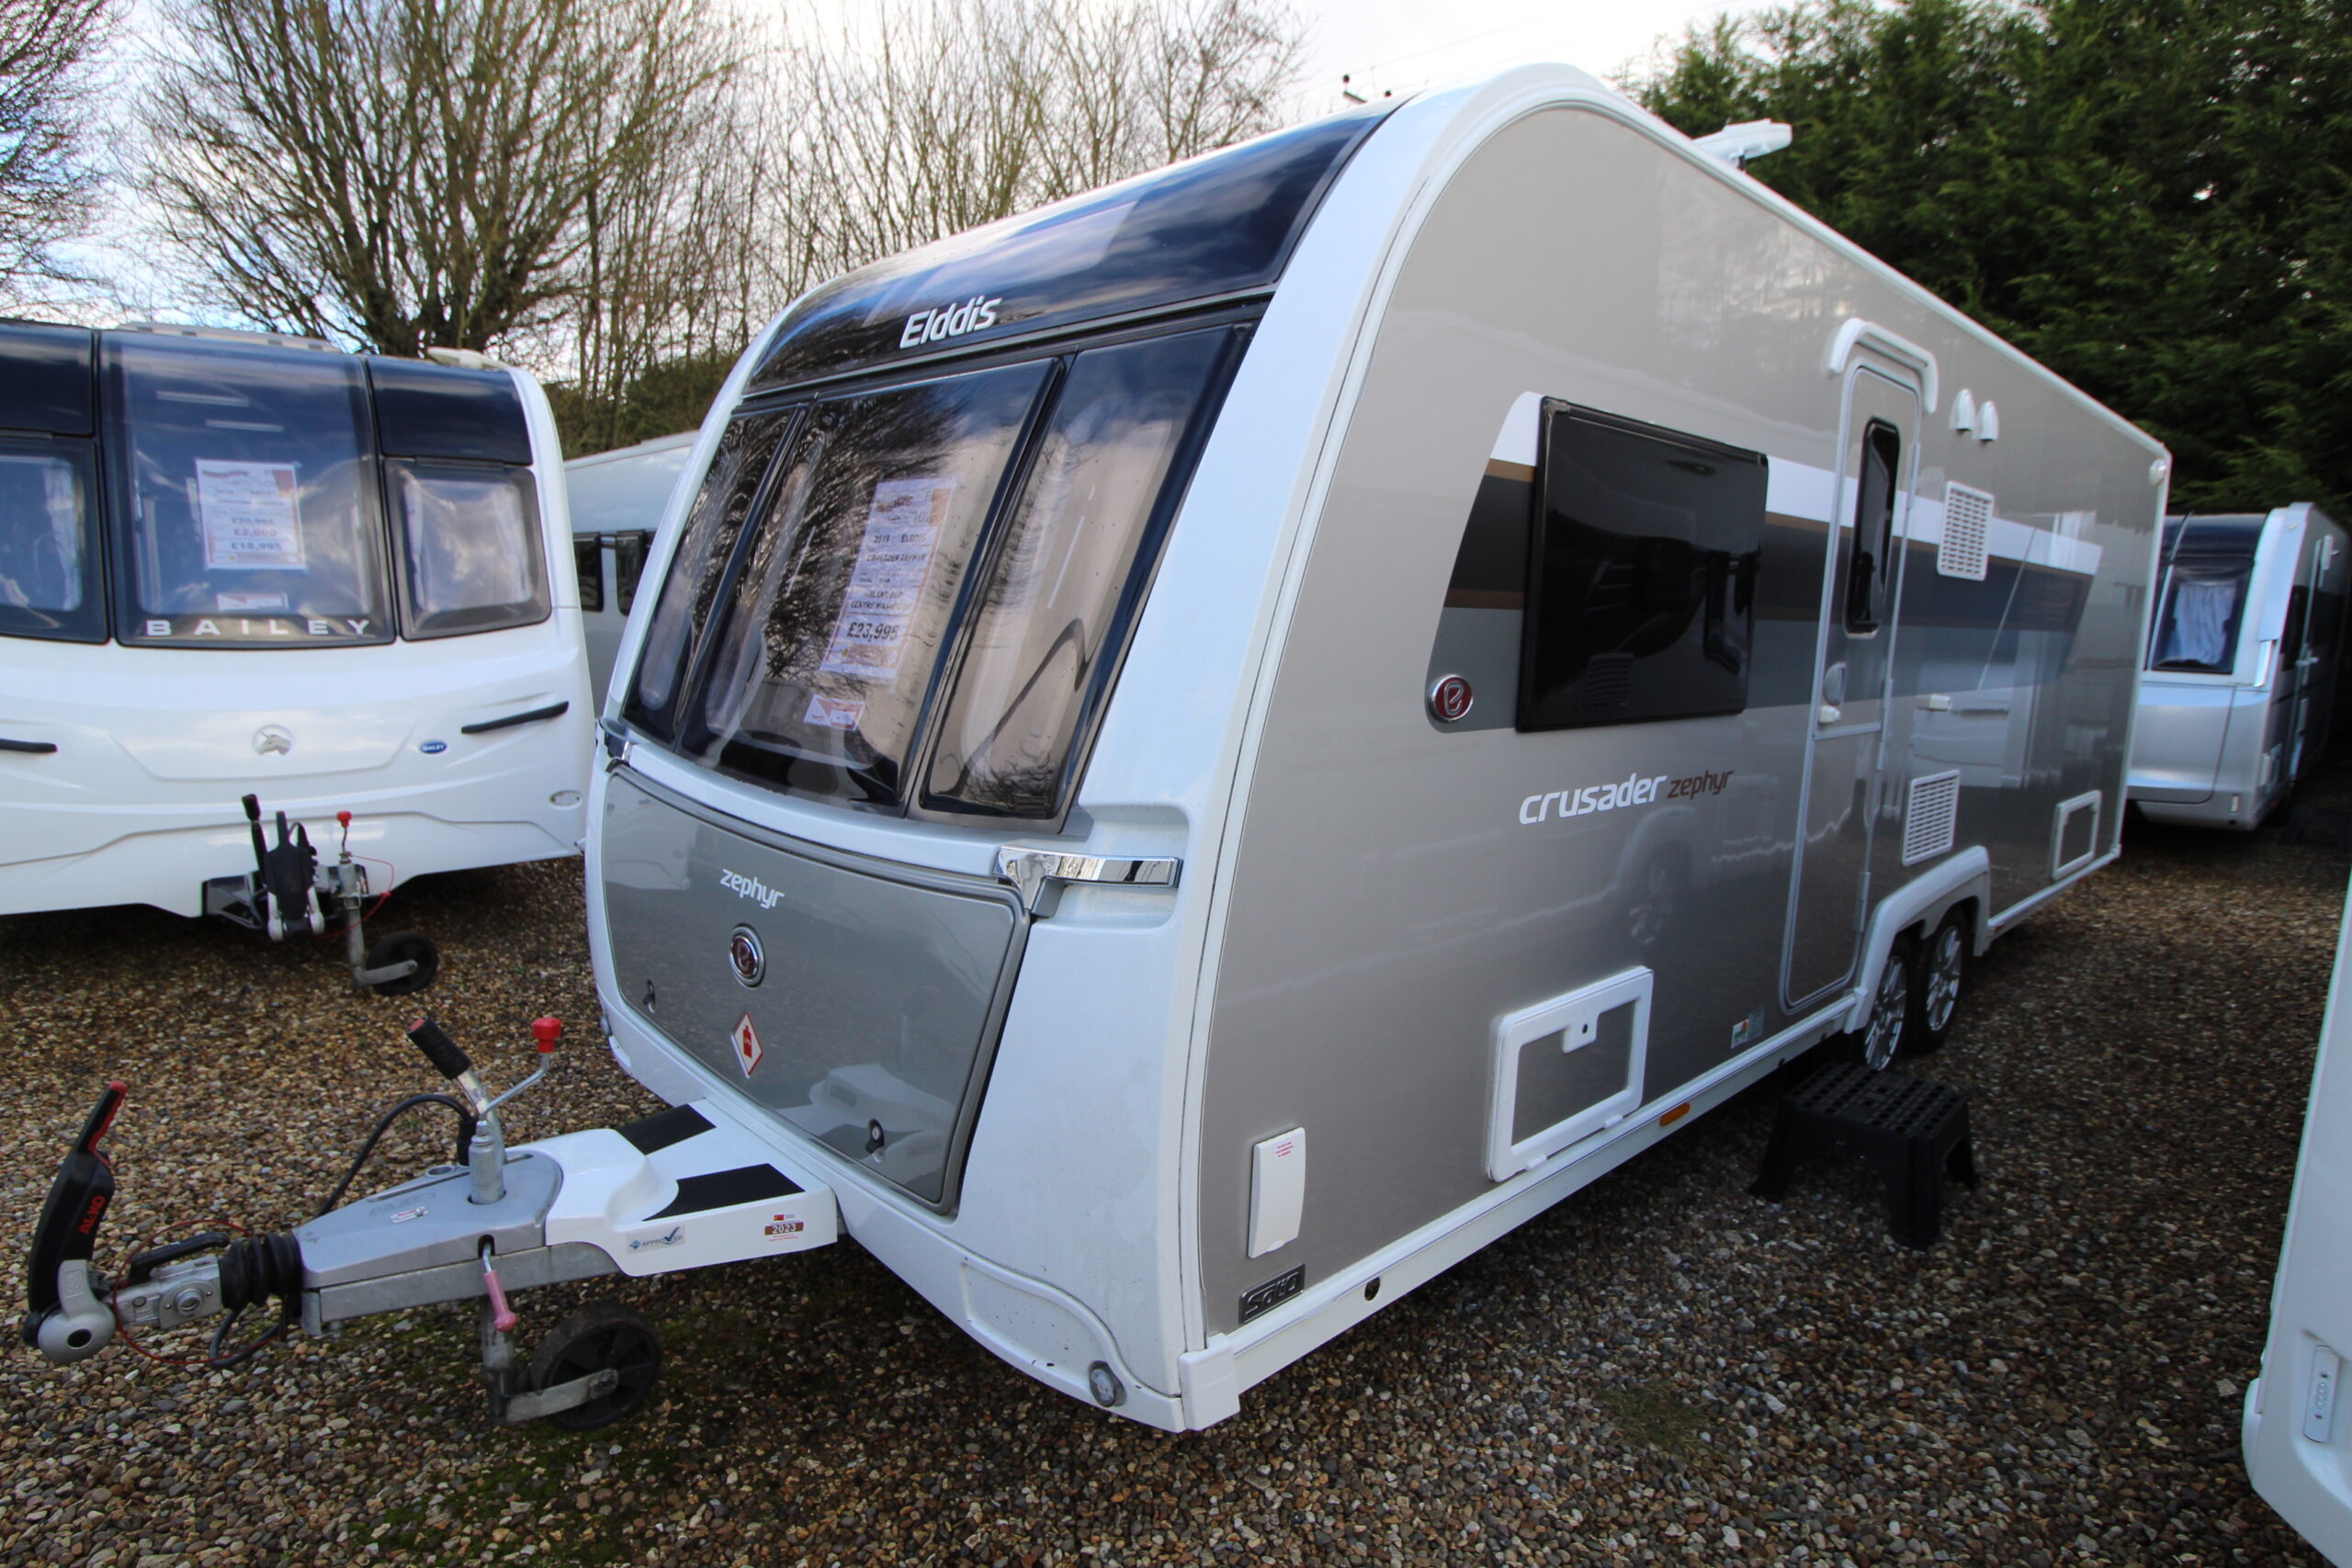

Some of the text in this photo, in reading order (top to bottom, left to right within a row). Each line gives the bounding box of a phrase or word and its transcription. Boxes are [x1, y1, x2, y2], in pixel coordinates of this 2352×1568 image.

[899, 294, 1002, 349] Elddis
[874, 535, 890, 544] 2019
[146, 618, 369, 637] BAILEY
[847, 621, 899, 643] £23,995
[1519, 769, 1735, 825] crusader zephyr
[719, 868, 786, 909] zephyr
[773, 1223, 797, 1235] 2023
